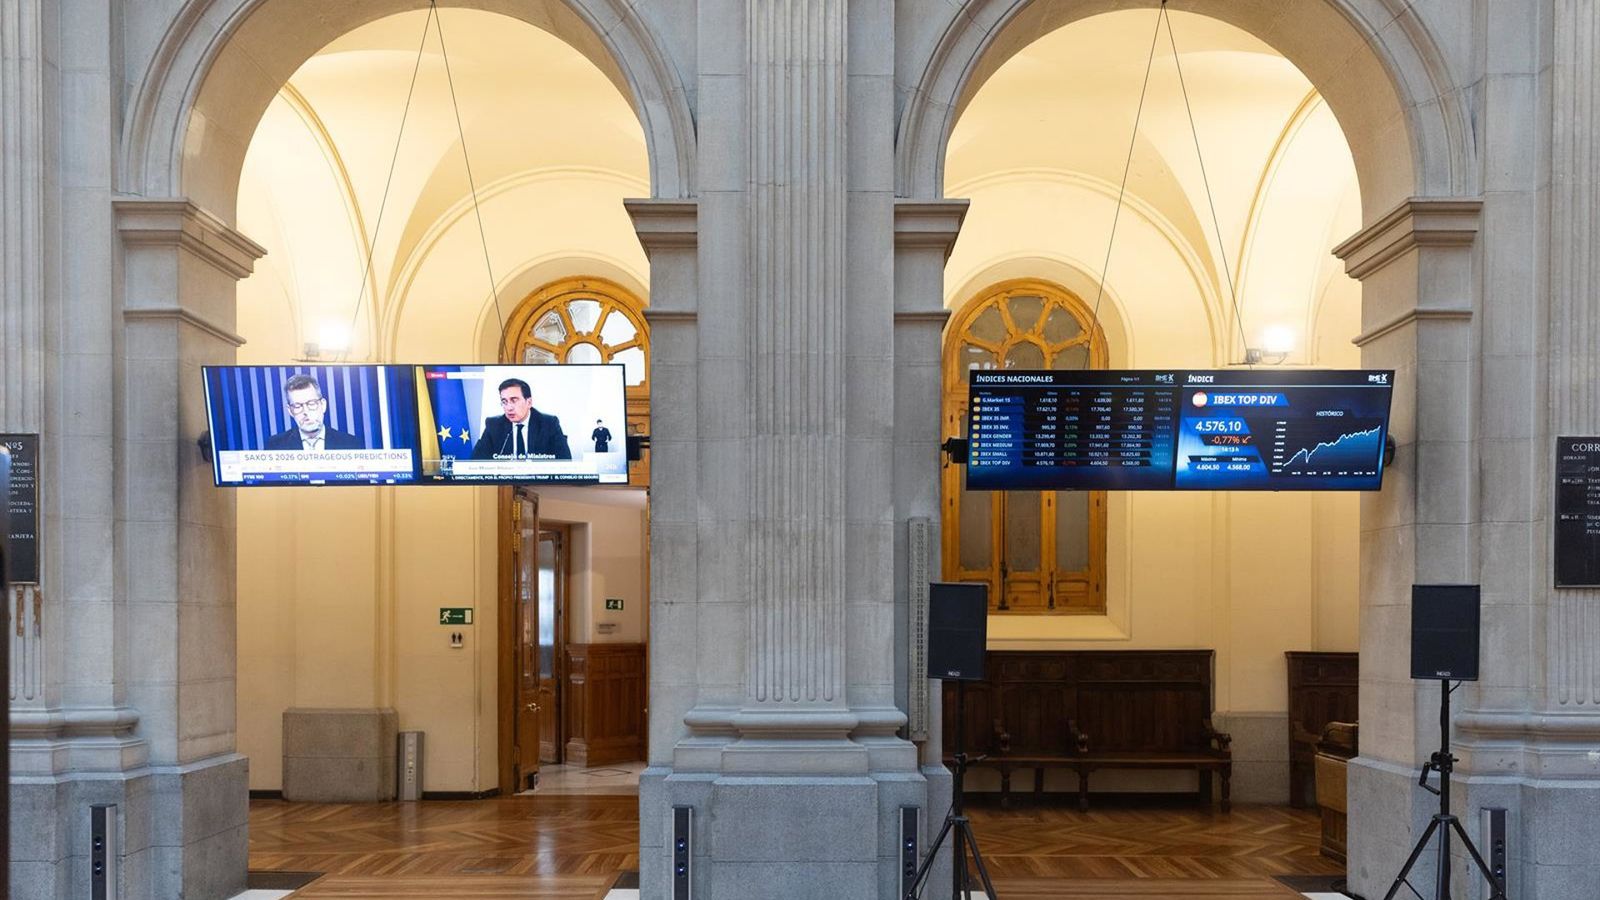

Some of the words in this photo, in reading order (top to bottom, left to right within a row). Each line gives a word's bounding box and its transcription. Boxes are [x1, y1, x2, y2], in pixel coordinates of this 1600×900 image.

[976, 374, 1006, 383] ÍNDICES
[1007, 375, 1054, 383] NACIONALES
[1188, 374, 1214, 383] ÍNDICE
[1213, 395, 1236, 405] IBEX
[1237, 395, 1258, 405] TOP
[1259, 395, 1277, 405] DIV
[1195, 421, 1242, 432] 4.576,10
[1211, 436, 1241, 445] -0,77%
[296, 453, 353, 461] OUTRAGEOUS
[354, 452, 408, 461] PREDICTIONS
[492, 453, 517, 461] Consejo
